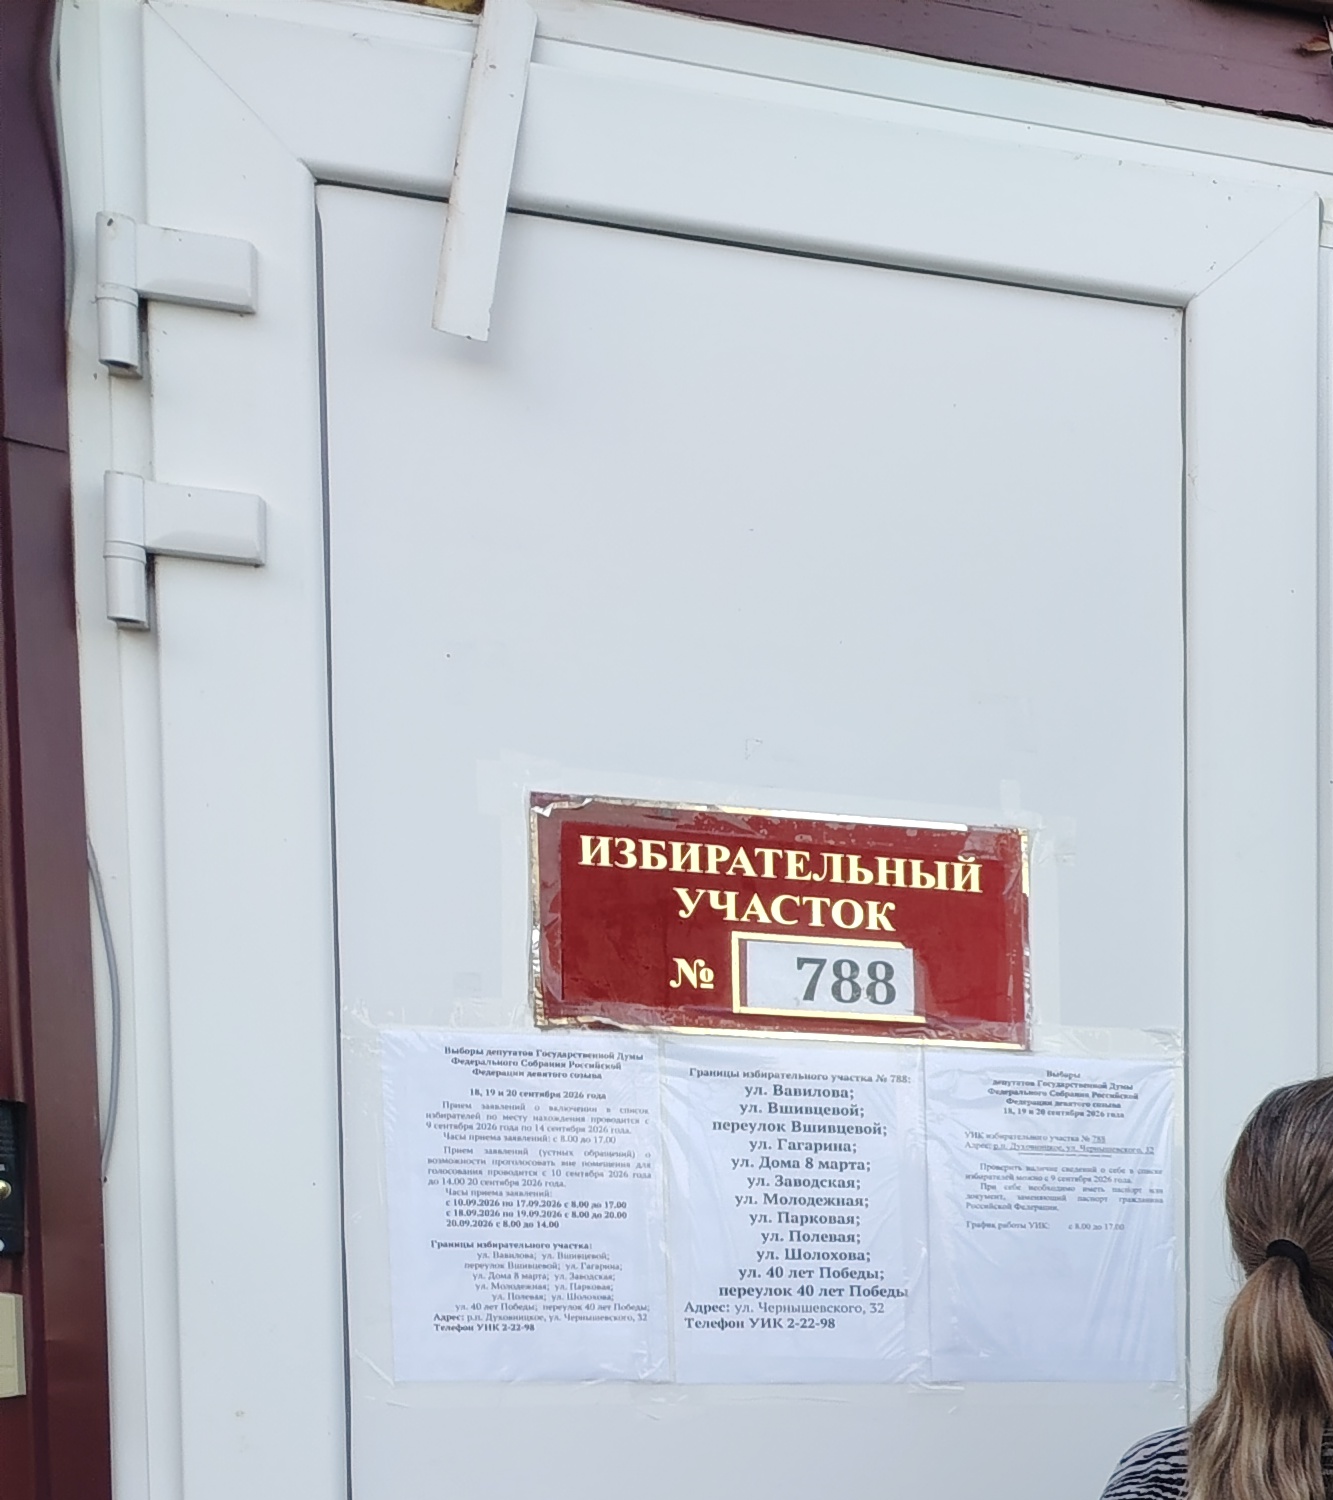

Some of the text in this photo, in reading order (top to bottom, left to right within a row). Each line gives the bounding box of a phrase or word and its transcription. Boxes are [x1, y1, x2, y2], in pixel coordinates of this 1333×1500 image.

[578, 834, 983, 894] ИЗБИРАТЕЛЬНЫЙ
[672, 886, 896, 932] УЧАСТОК
[669, 956, 898, 1006] № 788
[688, 1067, 910, 1083] Границы избирательного участка № 788:
[744, 1083, 854, 1098] ул. Вавилова;
[739, 1101, 864, 1116] ул. Вшивцевой;
[712, 1120, 887, 1135] переулок Вшивцевой;
[748, 1138, 856, 1154] ул. Гагарина;
[730, 1155, 870, 1172] ул. Дома 8 марта;
[746, 1174, 860, 1189] ул. Заводская;
[734, 1192, 868, 1207] ул. Молодежная;
[748, 1211, 860, 1226] ул. Парковая;
[760, 1229, 860, 1244] ул. Полевая;
[756, 1247, 870, 1262] ул. Шолохова;
[738, 1265, 884, 1280] ул. 40 лет Победы;
[718, 1286, 792, 1299] переулок
[796, 1284, 814, 1296] 40
[818, 1287, 845, 1296] лет
[683, 1301, 884, 1315] Адрес: ул. Чернышевского, 32
[683, 1317, 835, 1329] Телефон УИК 2-22-98
